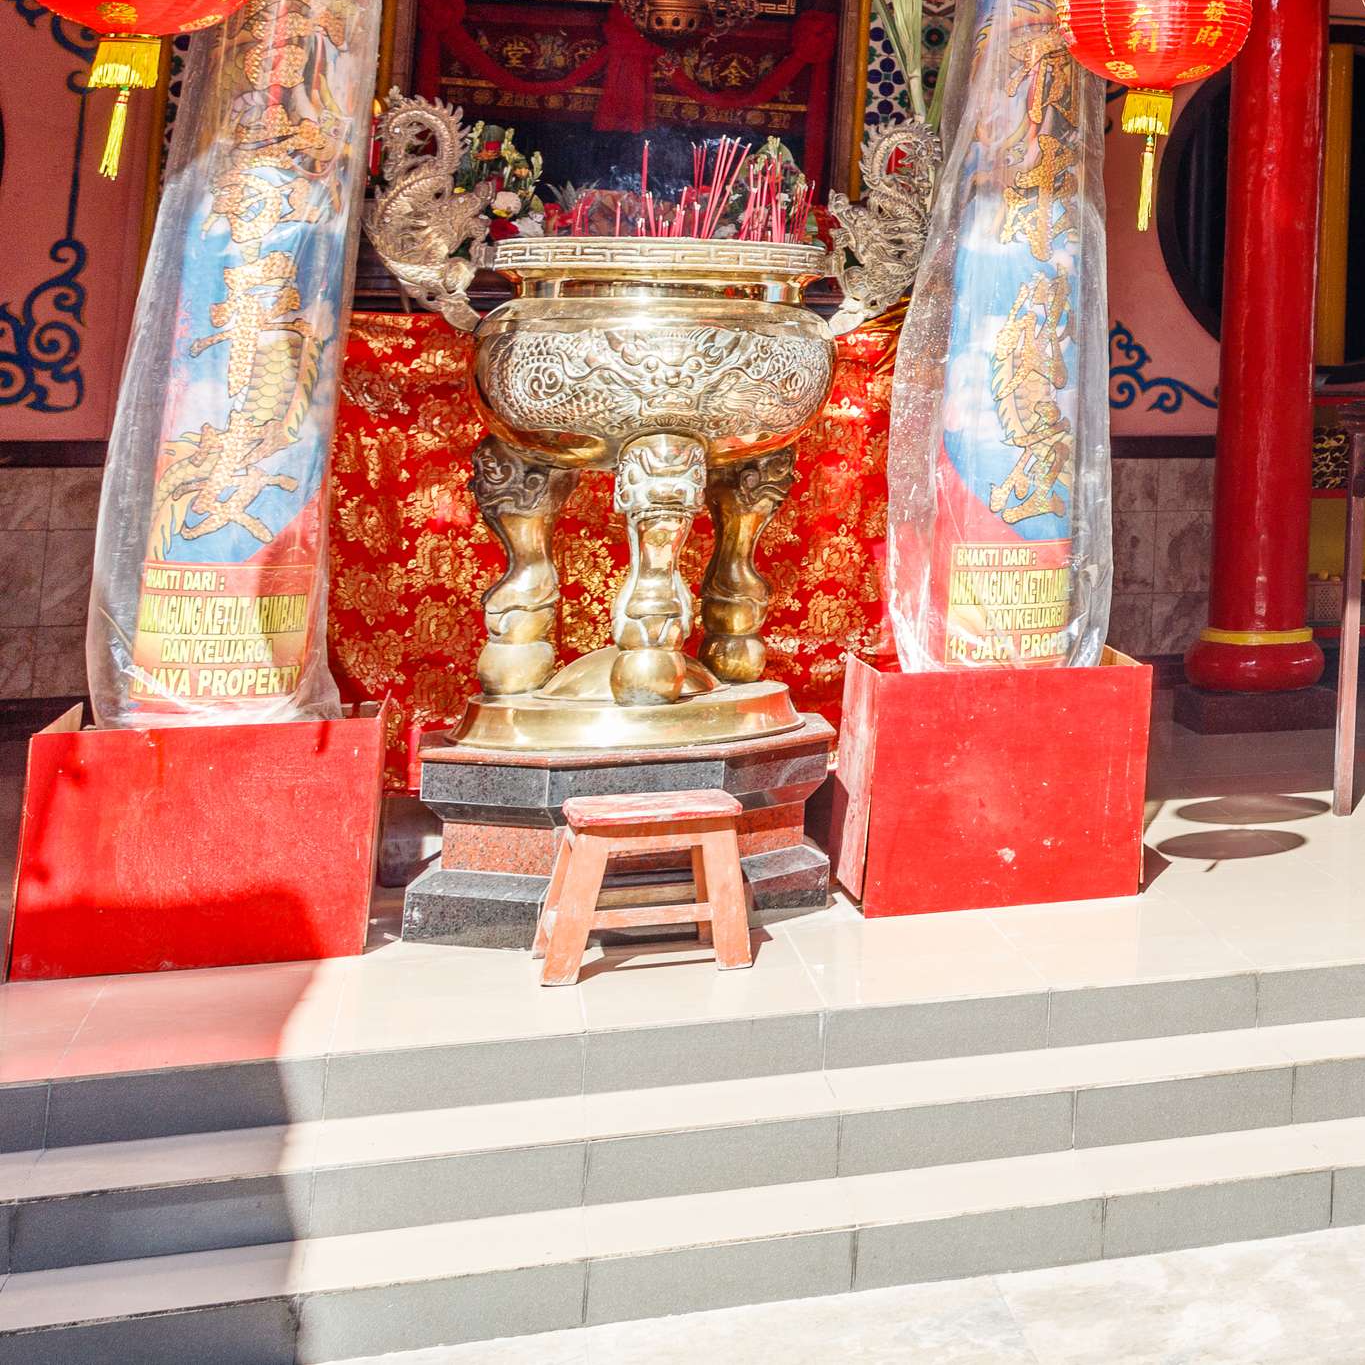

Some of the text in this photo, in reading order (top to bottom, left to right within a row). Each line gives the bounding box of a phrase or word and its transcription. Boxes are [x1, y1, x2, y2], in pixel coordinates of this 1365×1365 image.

[957, 548, 999, 566] BHAKTI
[1002, 548, 1030, 566] DARI
[183, 571, 216, 591] DARI
[982, 570, 1021, 605] AGUNG
[1021, 568, 1053, 604] KETUT
[159, 595, 203, 634] AGUNG
[203, 595, 250, 634] KETUT
[985, 608, 1013, 631] DAN
[160, 638, 273, 664] DAN KELUARGA
[949, 634, 967, 660] 18
[972, 634, 1014, 660] JAYA
[197, 666, 301, 696] PROPERTY
